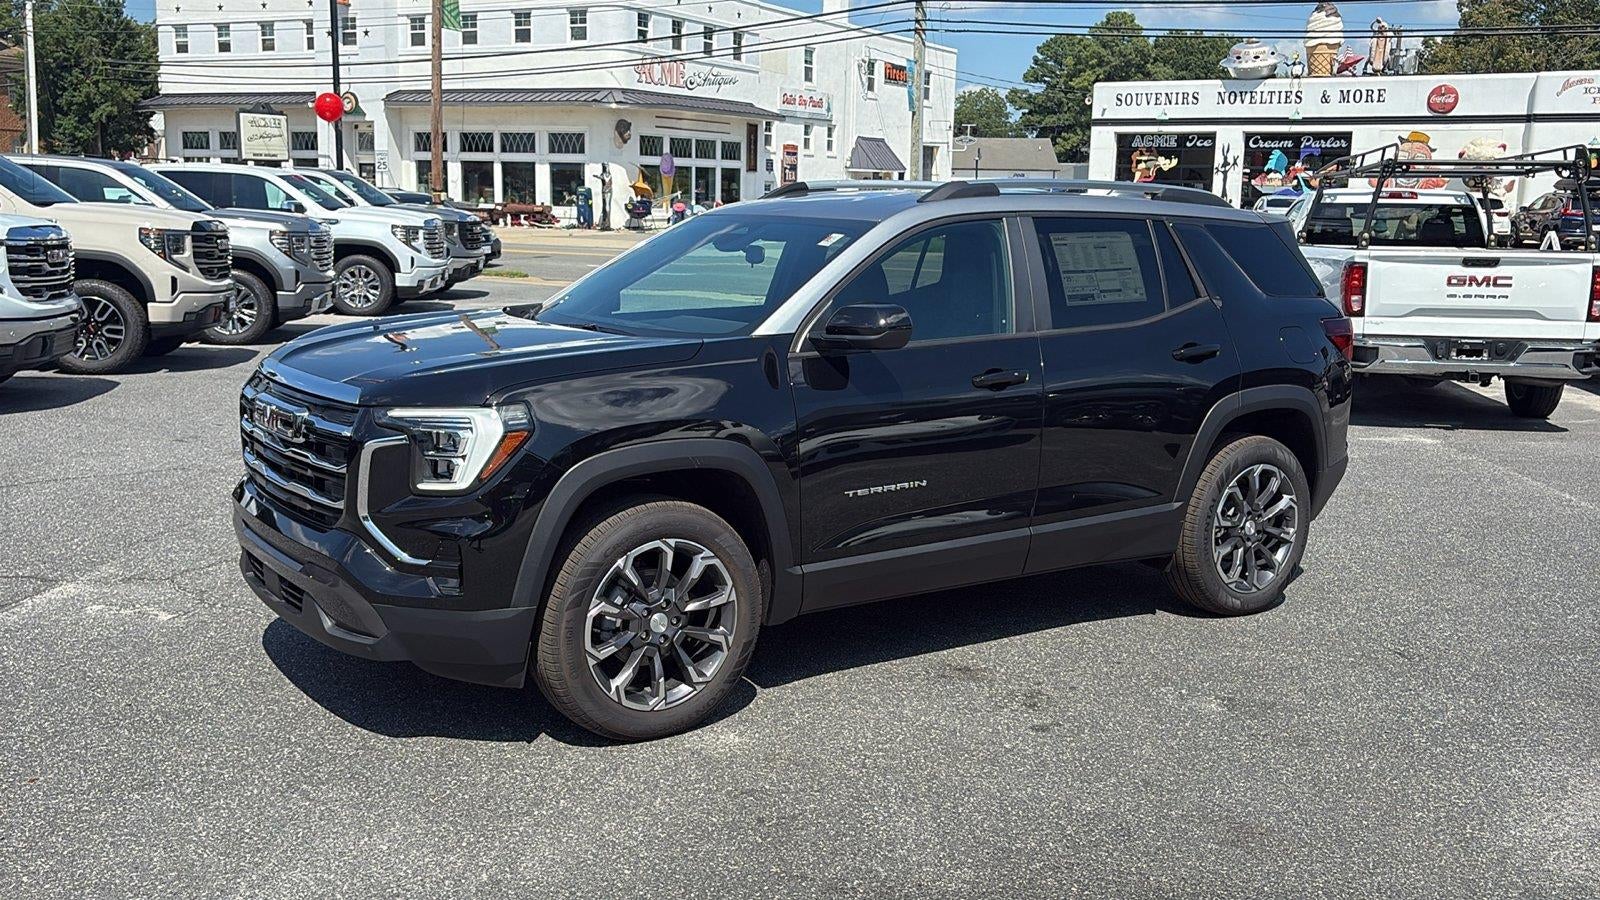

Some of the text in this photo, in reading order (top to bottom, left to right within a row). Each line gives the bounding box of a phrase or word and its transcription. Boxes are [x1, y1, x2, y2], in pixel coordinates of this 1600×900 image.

[633, 55, 686, 89] ACME
[1115, 88, 1387, 107] SOUVENIRS NOVELTIES & MORE
[1131, 134, 1214, 148] ACME Ice
[1249, 135, 1350, 149] Cream Parlor
[377, 161, 388, 170] 25
[1446, 275, 1513, 288] GMC
[844, 479, 928, 498] TERRAIN
